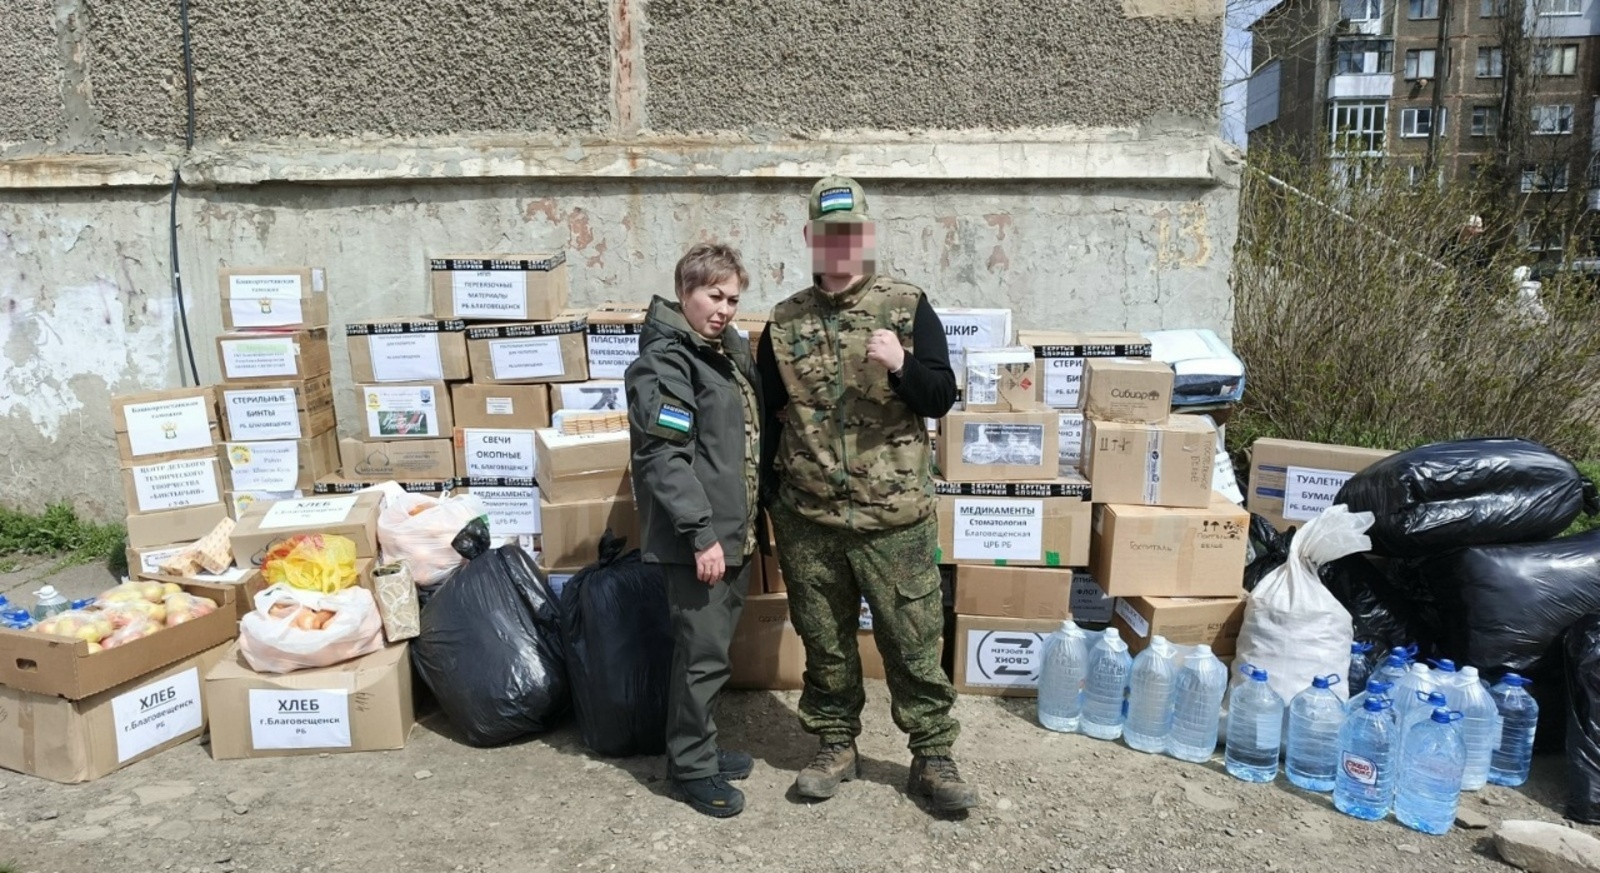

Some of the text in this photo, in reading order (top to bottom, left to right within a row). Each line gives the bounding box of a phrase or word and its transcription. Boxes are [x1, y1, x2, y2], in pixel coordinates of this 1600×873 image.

[945, 325, 978, 336] ШКИР
[591, 336, 636, 344] ПЛАСТЫРИ
[232, 395, 286, 404] СТЕРИЛЬНЫЕ
[483, 436, 511, 444] СВЕЧИ
[476, 451, 521, 460] ОКОПНЫЕ
[1297, 475, 1342, 486] ТУАЛЕТН
[960, 506, 1035, 515] МЕДИКАМЕНТЫ
[965, 530, 1030, 538] Благовещенская
[140, 686, 176, 710] ХЛЕБ
[278, 699, 320, 711] ХЛЕБ
[124, 699, 194, 732] г.Благовещенск
[156, 722, 165, 730] РБ
[260, 718, 340, 726] г.Благовещенск
